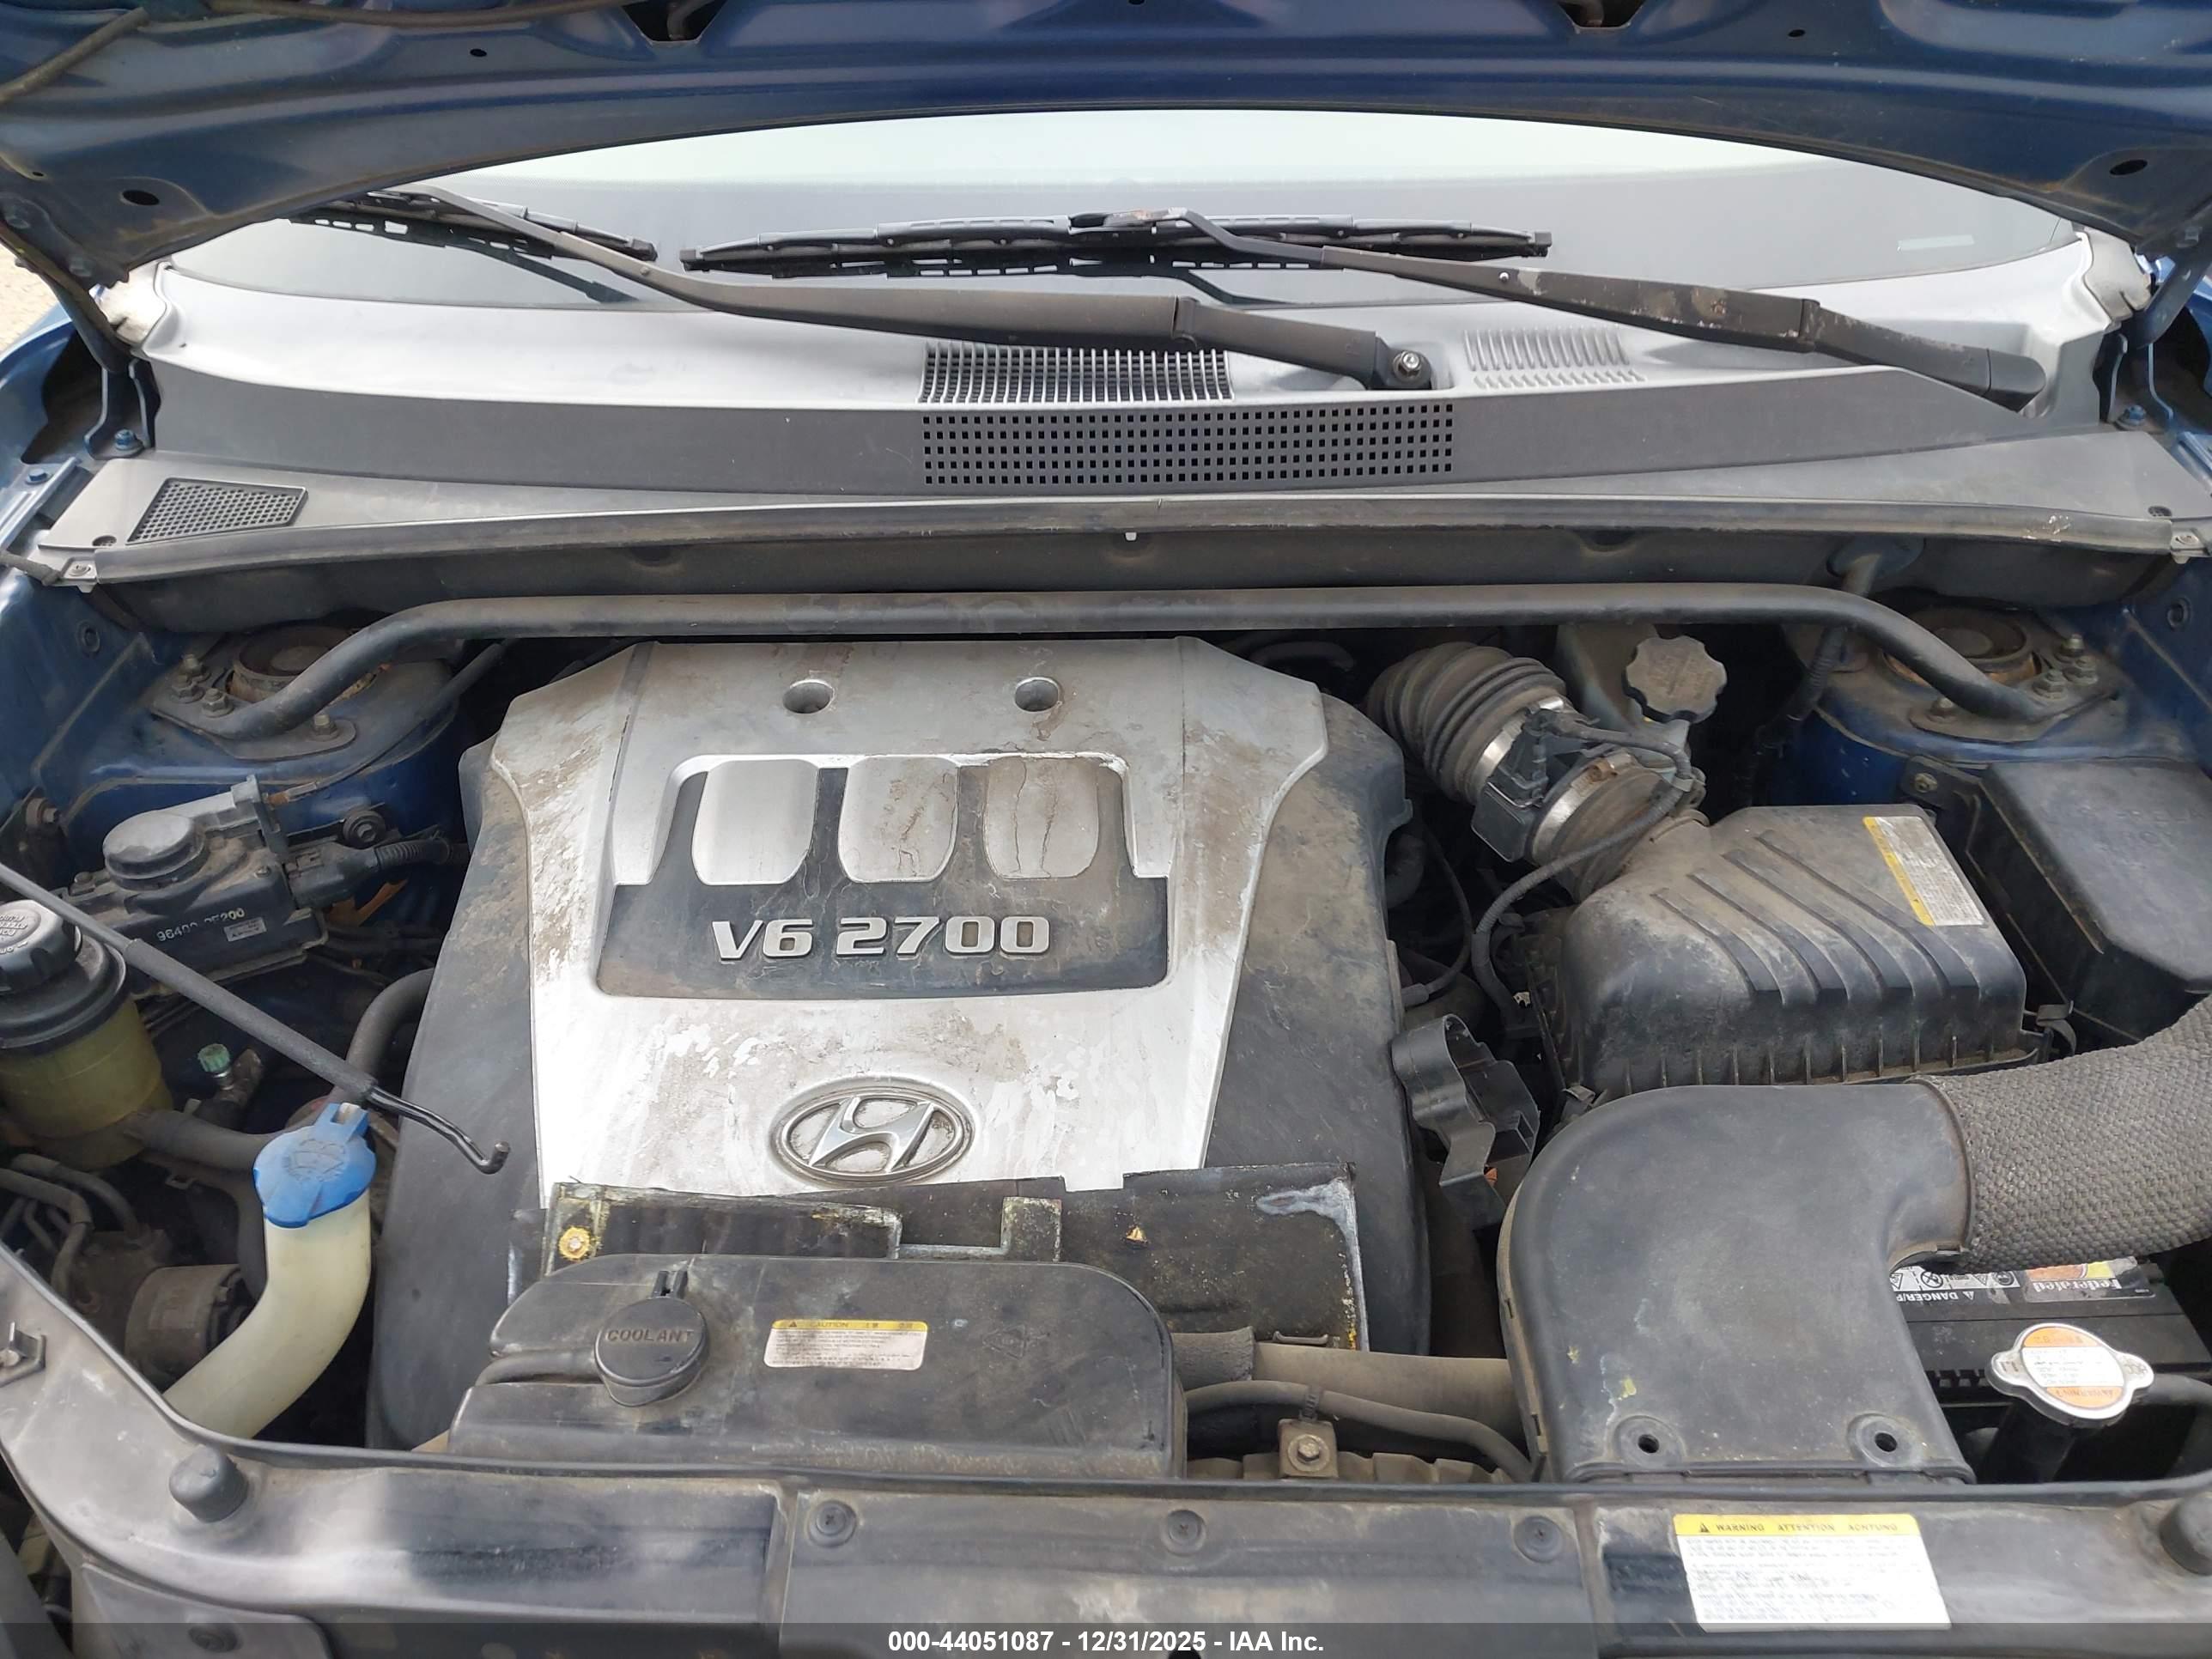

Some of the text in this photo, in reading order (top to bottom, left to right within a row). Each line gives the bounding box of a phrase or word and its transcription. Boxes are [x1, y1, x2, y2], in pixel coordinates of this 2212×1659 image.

[712, 915, 1050, 960] V6 2700
[2033, 1278, 2123, 1291] Federated
[605, 1328, 695, 1341] COOLANT
[1717, 1523, 1899, 1532] WARNING ATTENTION ACHTUNG
